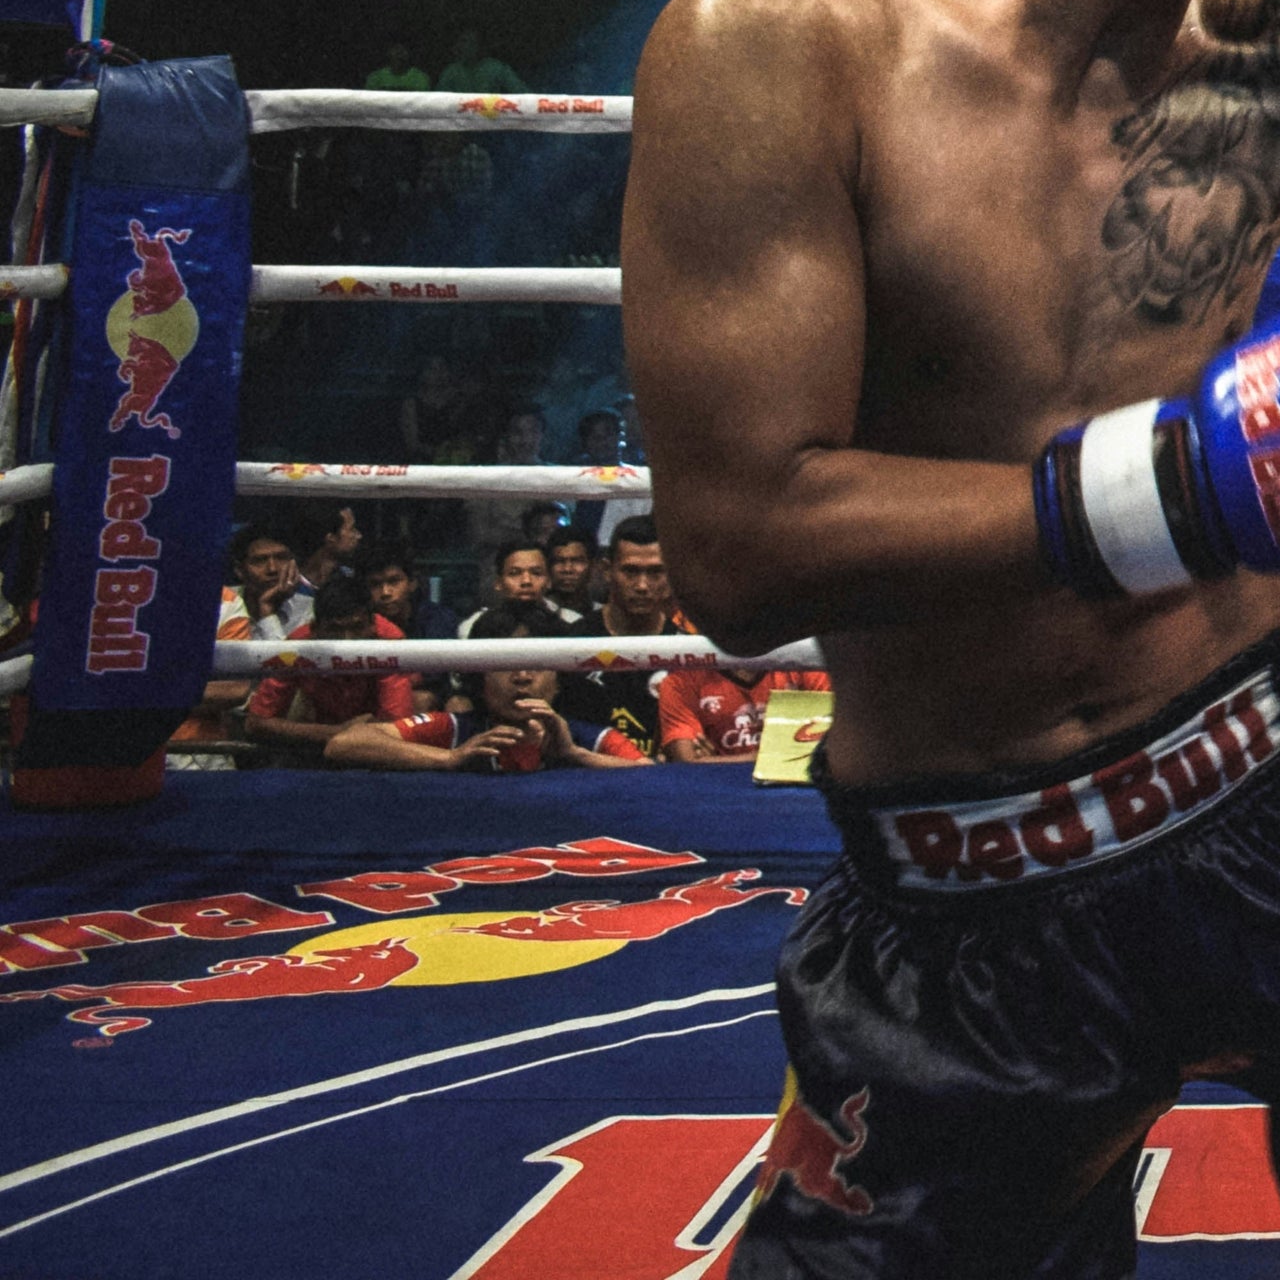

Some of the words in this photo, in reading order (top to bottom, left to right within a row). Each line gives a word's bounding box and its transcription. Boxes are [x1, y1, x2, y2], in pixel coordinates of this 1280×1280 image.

[389, 281, 422, 298] Red
[424, 282, 459, 299] Bull
[99, 453, 172, 563] Red
[85, 564, 158, 675] Bull
[895, 783, 1096, 882] Red
[1092, 687, 1275, 843] Bull
[293, 836, 707, 914] Red
[0, 892, 337, 974] Bul
